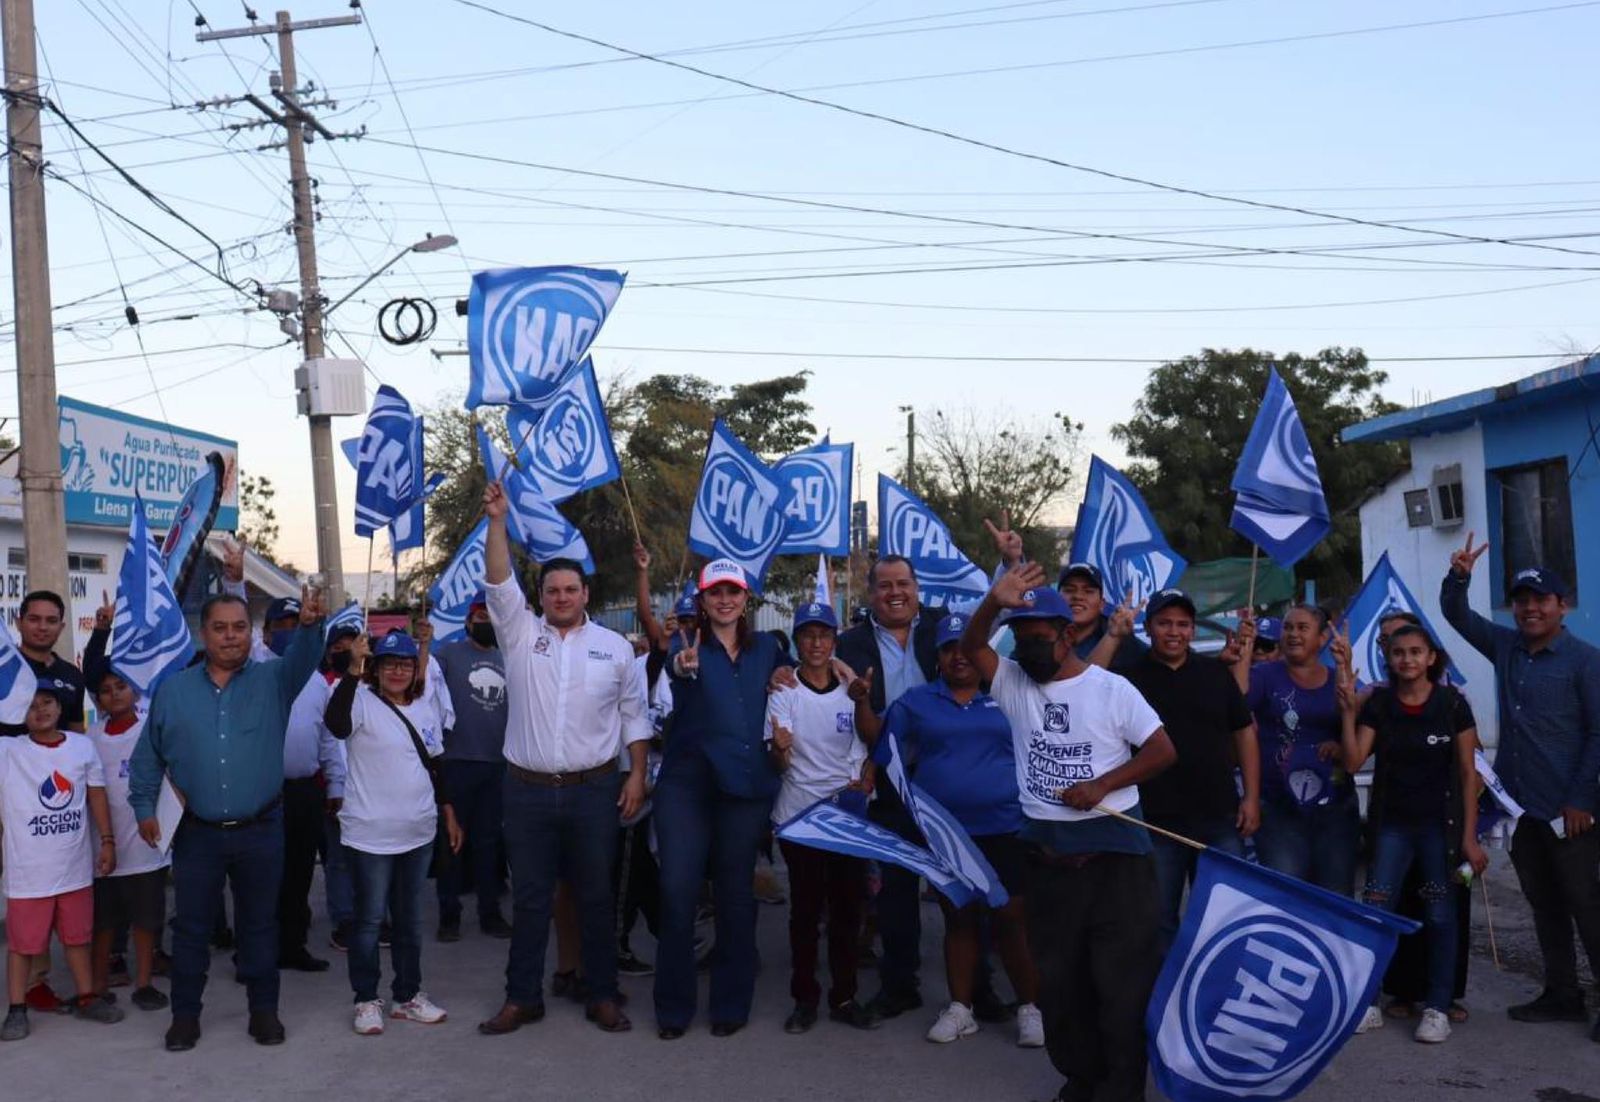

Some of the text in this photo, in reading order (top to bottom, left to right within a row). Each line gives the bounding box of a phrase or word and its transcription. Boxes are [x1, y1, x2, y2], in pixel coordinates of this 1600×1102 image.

[124, 431, 200, 460] Agua Purificada
[94, 497, 128, 517] Llena
[709, 467, 771, 545] PAN
[1030, 738, 1092, 758] JÓVENES
[1027, 766, 1075, 788] SEGUIMO
[28, 809, 81, 826] ACCIÓN
[1206, 937, 1321, 1070] PAN
